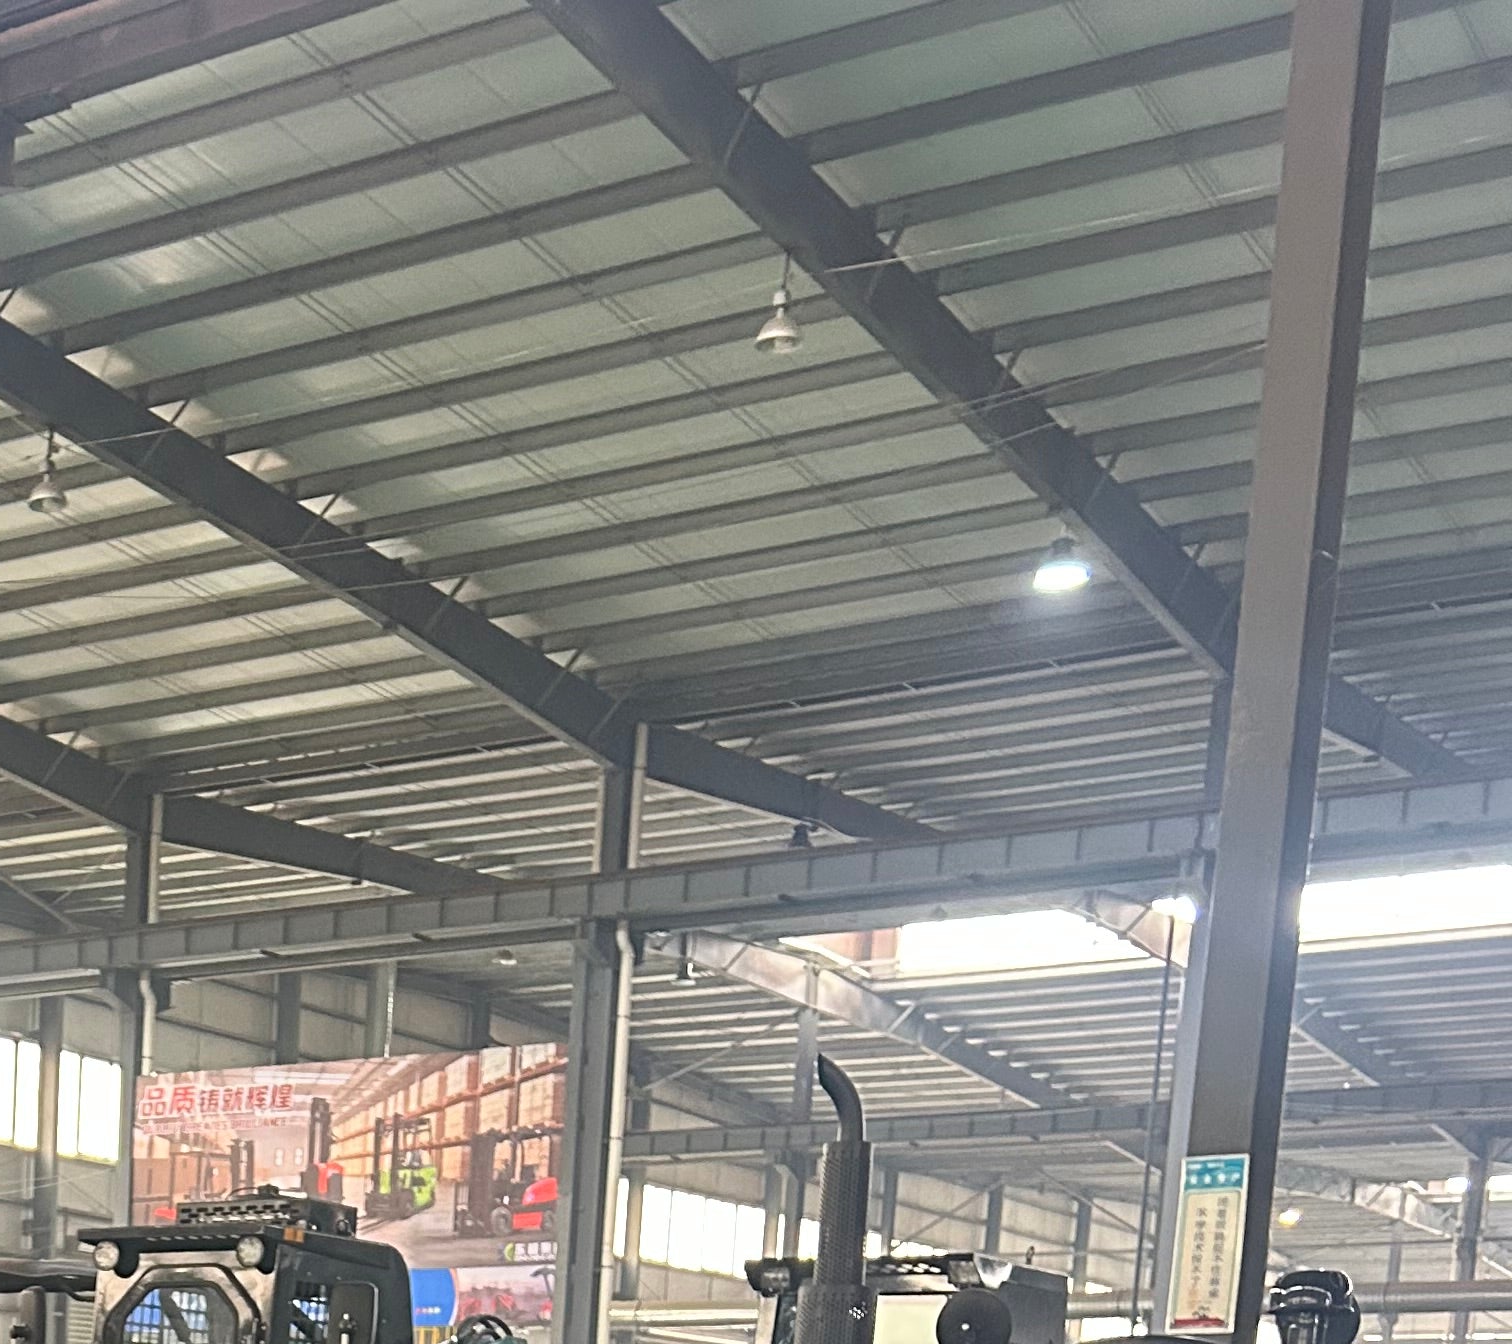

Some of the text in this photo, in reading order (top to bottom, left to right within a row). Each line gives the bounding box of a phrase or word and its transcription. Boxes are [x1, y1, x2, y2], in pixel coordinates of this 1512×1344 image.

[140, 1083, 294, 1118] 品质铸就辉煌
